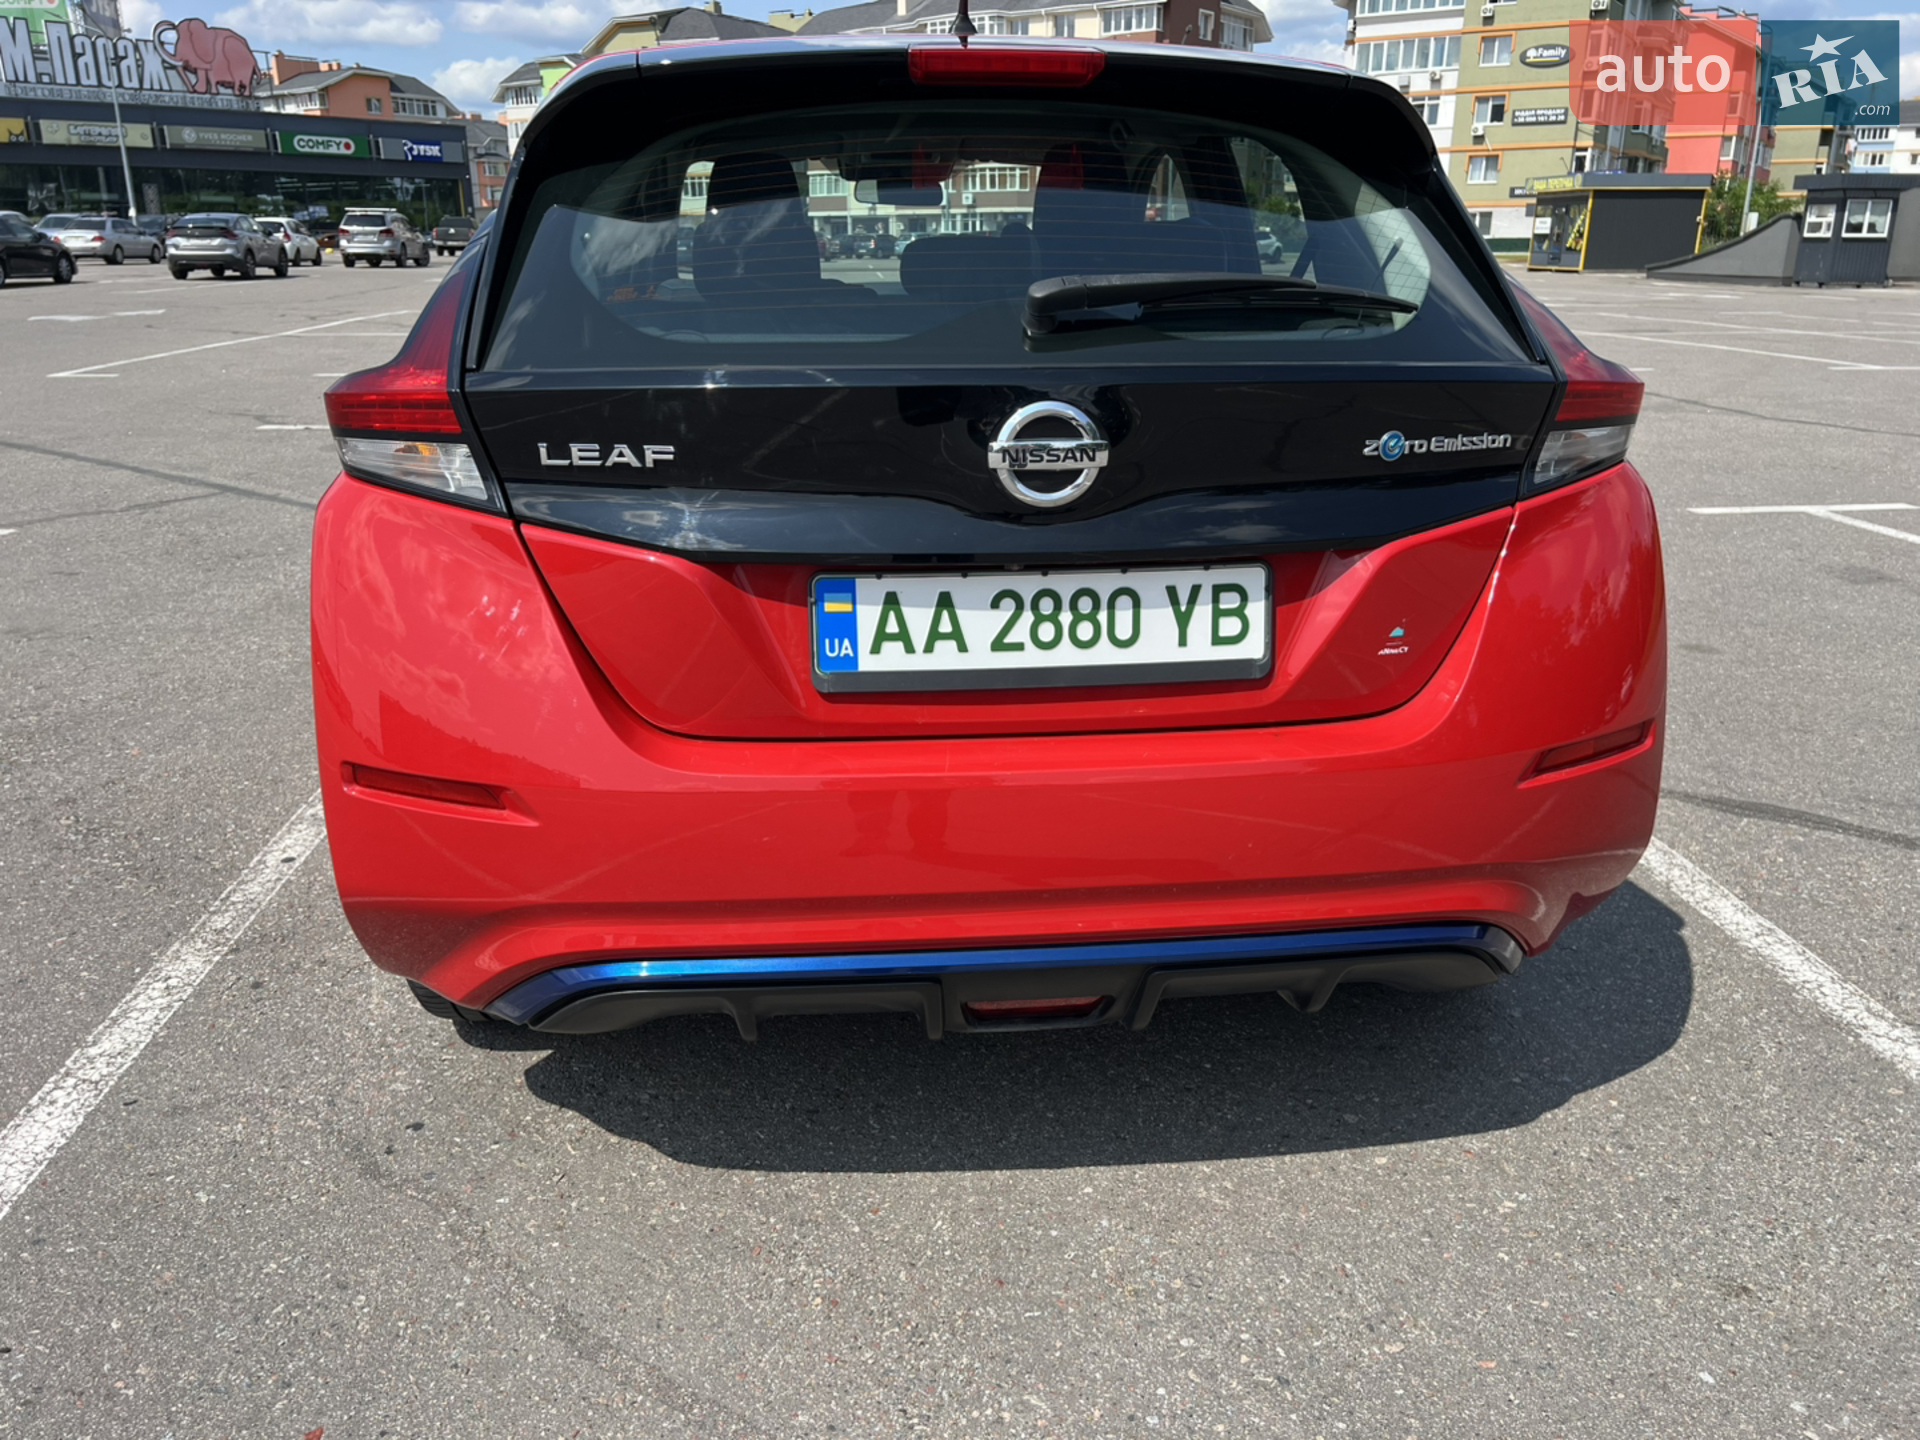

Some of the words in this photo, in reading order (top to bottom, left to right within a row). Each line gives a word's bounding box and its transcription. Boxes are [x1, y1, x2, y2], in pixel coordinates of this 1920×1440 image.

[0, 16, 171, 91] М.Пасаж
[1538, 46, 1567, 58] Family
[220, 133, 253, 141] ROCHER
[296, 137, 342, 151] COMFY
[411, 144, 441, 157] JYSK
[1430, 432, 1512, 453] Emission
[537, 443, 676, 468] LEAF
[1001, 447, 1097, 464] NISSAN
[869, 591, 969, 655] AA
[990, 586, 1141, 652] 2880
[1165, 583, 1250, 648] YB
[825, 637, 854, 657] UA
